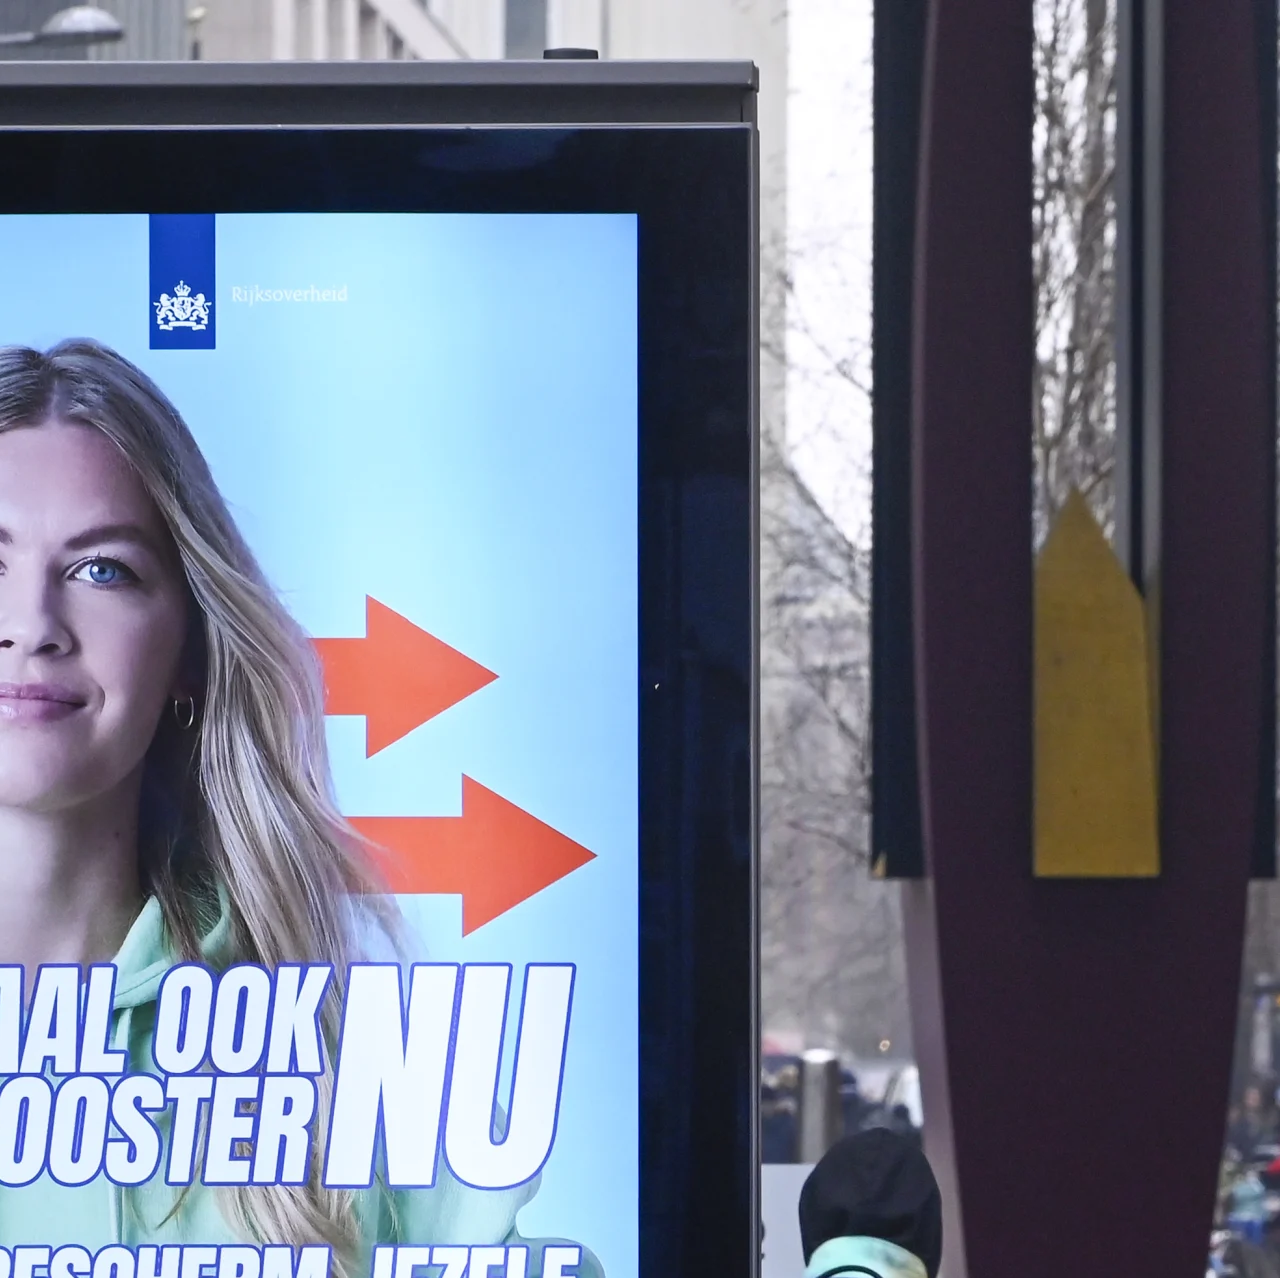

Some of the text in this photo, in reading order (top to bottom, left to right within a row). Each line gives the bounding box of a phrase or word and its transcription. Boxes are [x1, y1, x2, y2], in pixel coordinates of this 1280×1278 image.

[231, 284, 348, 306] Rijksoverheid
[152, 962, 334, 1076] OOK
[321, 960, 577, 1191] NU
